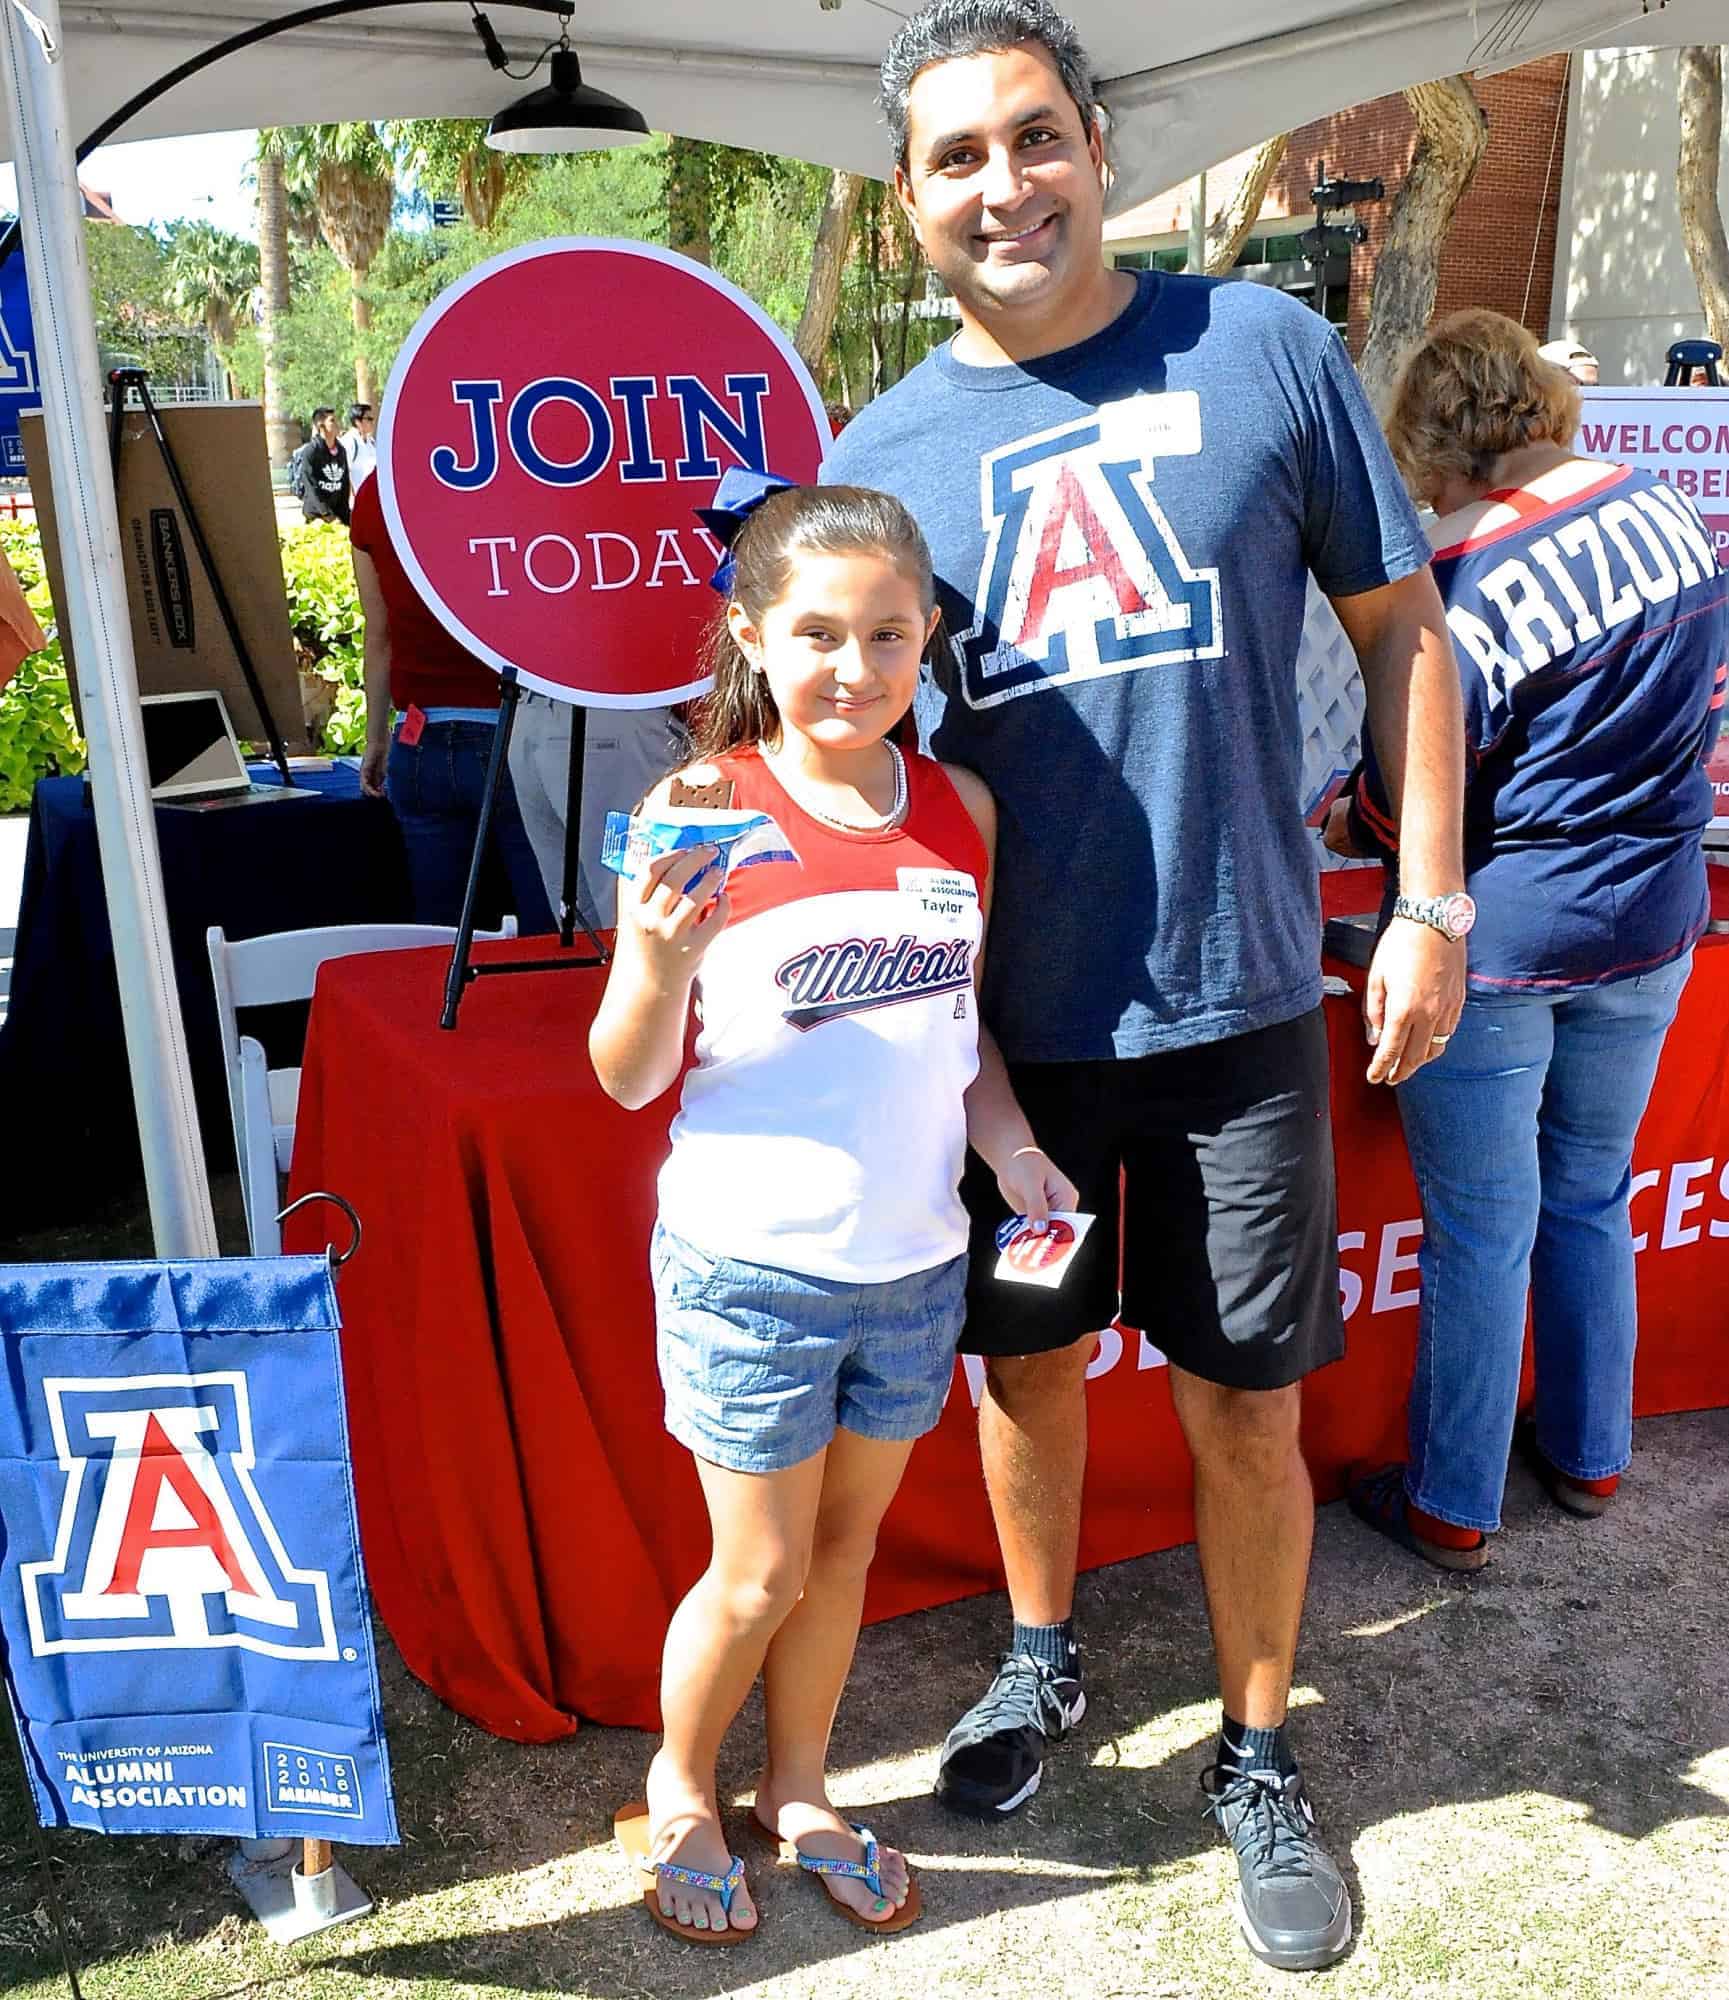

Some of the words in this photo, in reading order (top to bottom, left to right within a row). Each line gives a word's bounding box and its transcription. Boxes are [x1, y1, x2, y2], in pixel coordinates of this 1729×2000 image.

[430, 374, 770, 492] JOIN
[1446, 484, 1724, 711] ARIZON
[920, 899, 964, 914] Taylor
[776, 935, 973, 1006] Wildcats
[20, 1371, 340, 1661] A
[57, 1751, 77, 1762] THE
[79, 1747, 144, 1763] UNIVERSITY
[147, 1747, 161, 1757] OF
[164, 1744, 213, 1756] ARIZONA
[65, 1761, 174, 1786] ALUMNI
[72, 1785, 247, 1809] ASSOCIATION
